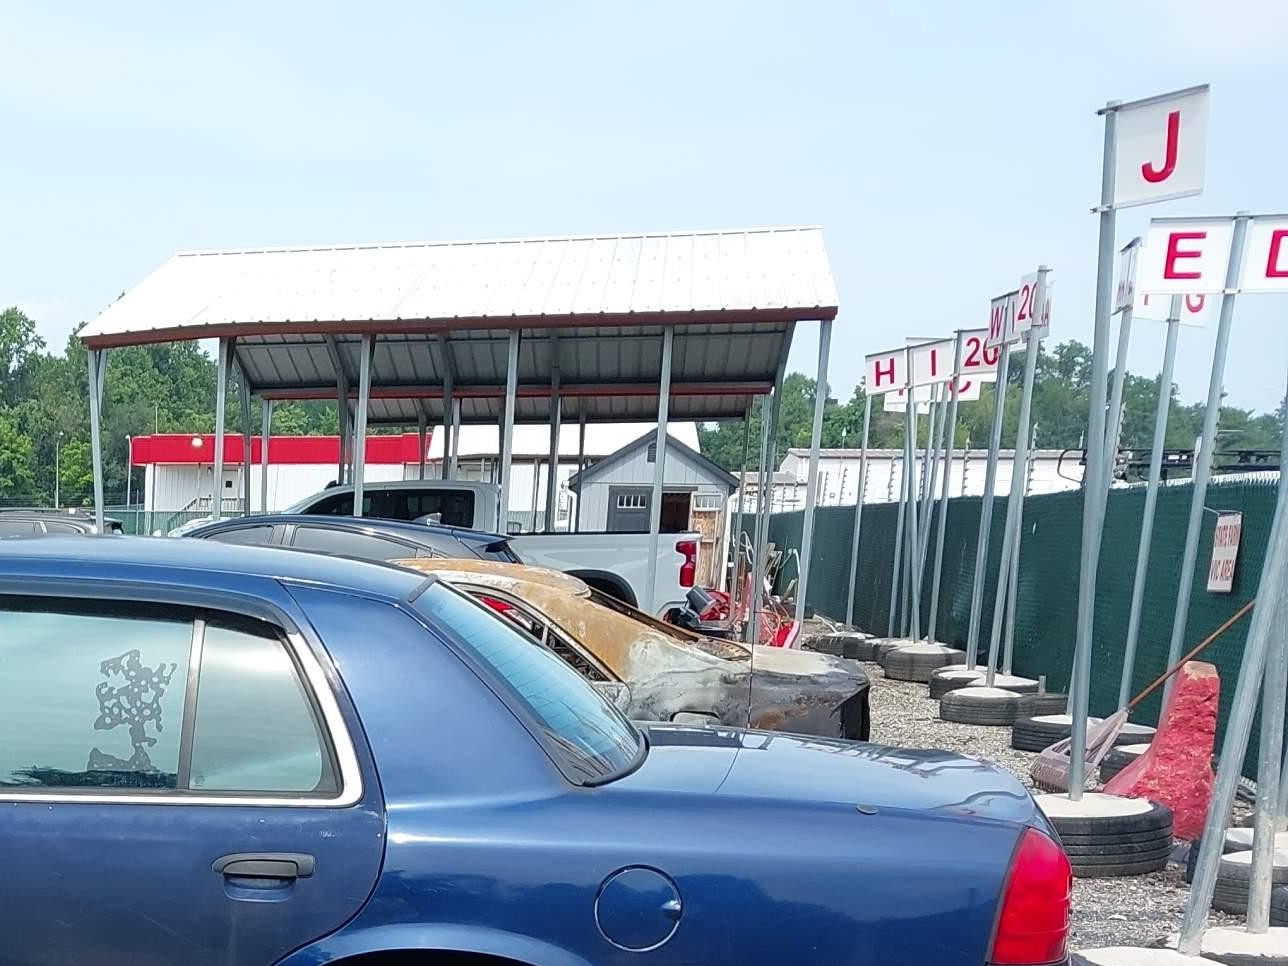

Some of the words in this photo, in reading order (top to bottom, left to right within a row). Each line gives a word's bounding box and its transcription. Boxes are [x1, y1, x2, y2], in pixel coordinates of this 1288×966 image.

[1141, 111, 1181, 184] J
[1162, 231, 1207, 280] E
[990, 304, 1005, 340] W
[874, 358, 896, 386] H
[930, 350, 937, 376] I
